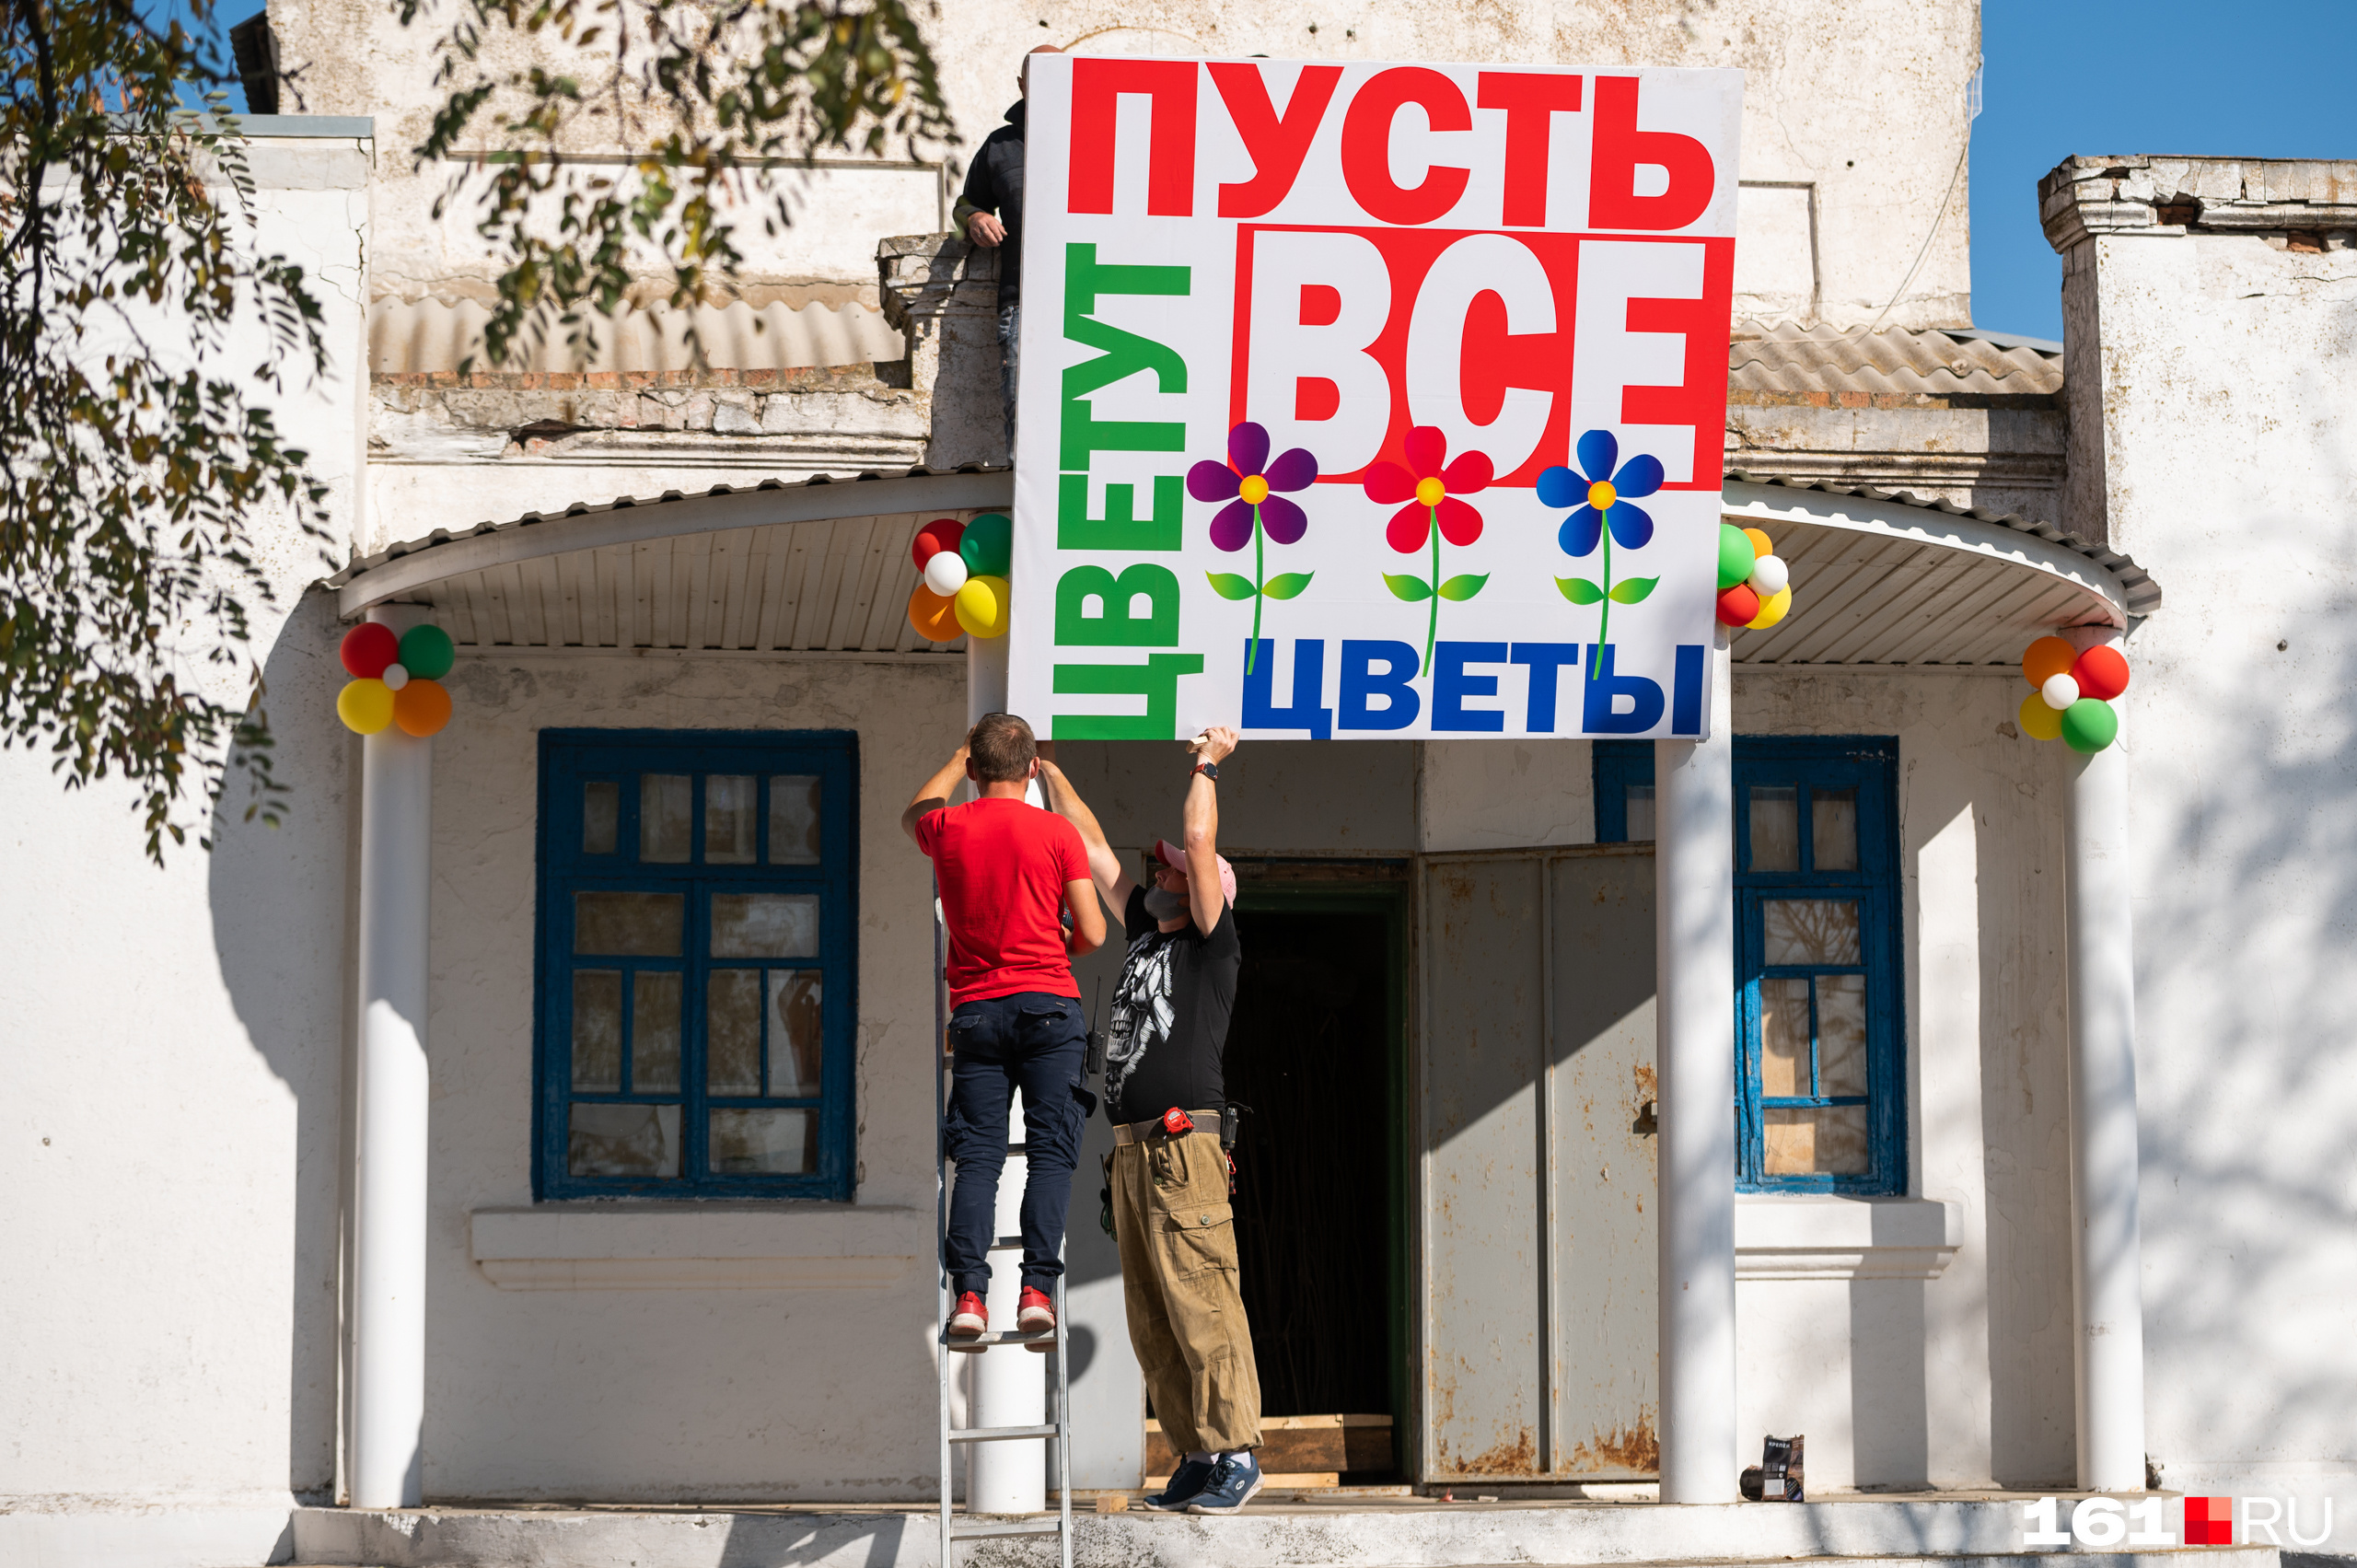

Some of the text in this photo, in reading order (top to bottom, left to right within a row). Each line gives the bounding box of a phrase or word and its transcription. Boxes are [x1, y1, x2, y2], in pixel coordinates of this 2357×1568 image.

[1068, 58, 1715, 230] ПУСТЬ
[1247, 231, 1706, 483] ВСЕ
[1051, 242, 1204, 741] ЦВЕТУТ
[1241, 637, 1704, 740] ЦВЕТЫ
